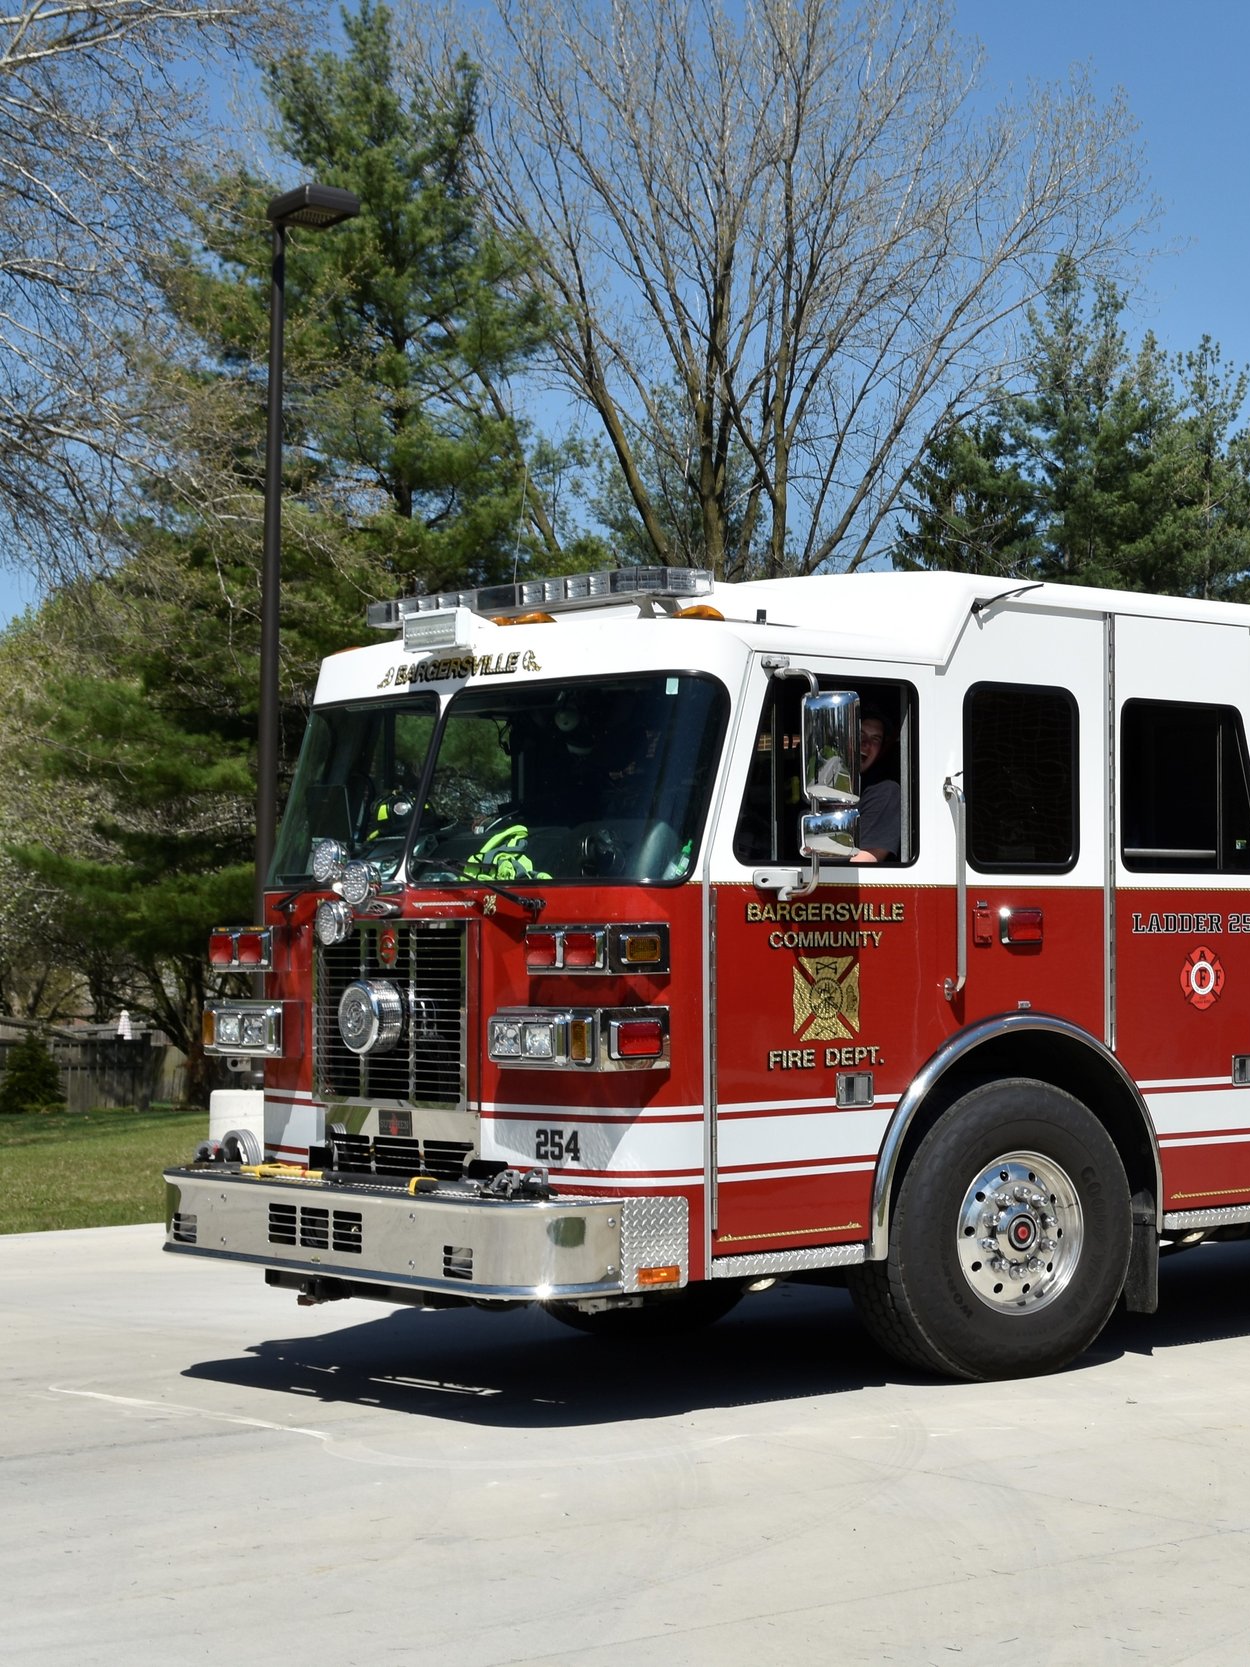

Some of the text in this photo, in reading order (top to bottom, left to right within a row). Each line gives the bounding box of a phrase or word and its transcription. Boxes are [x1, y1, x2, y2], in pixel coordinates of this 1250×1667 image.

[394, 652, 521, 686] BARGERSVILLE
[747, 902, 905, 923] BARGERSVILLE
[1132, 913, 1223, 934] LADDER
[769, 931, 883, 949] COMMUNITY
[767, 1046, 885, 1071] FIRE DEPT.
[536, 1129, 580, 1161] 254
